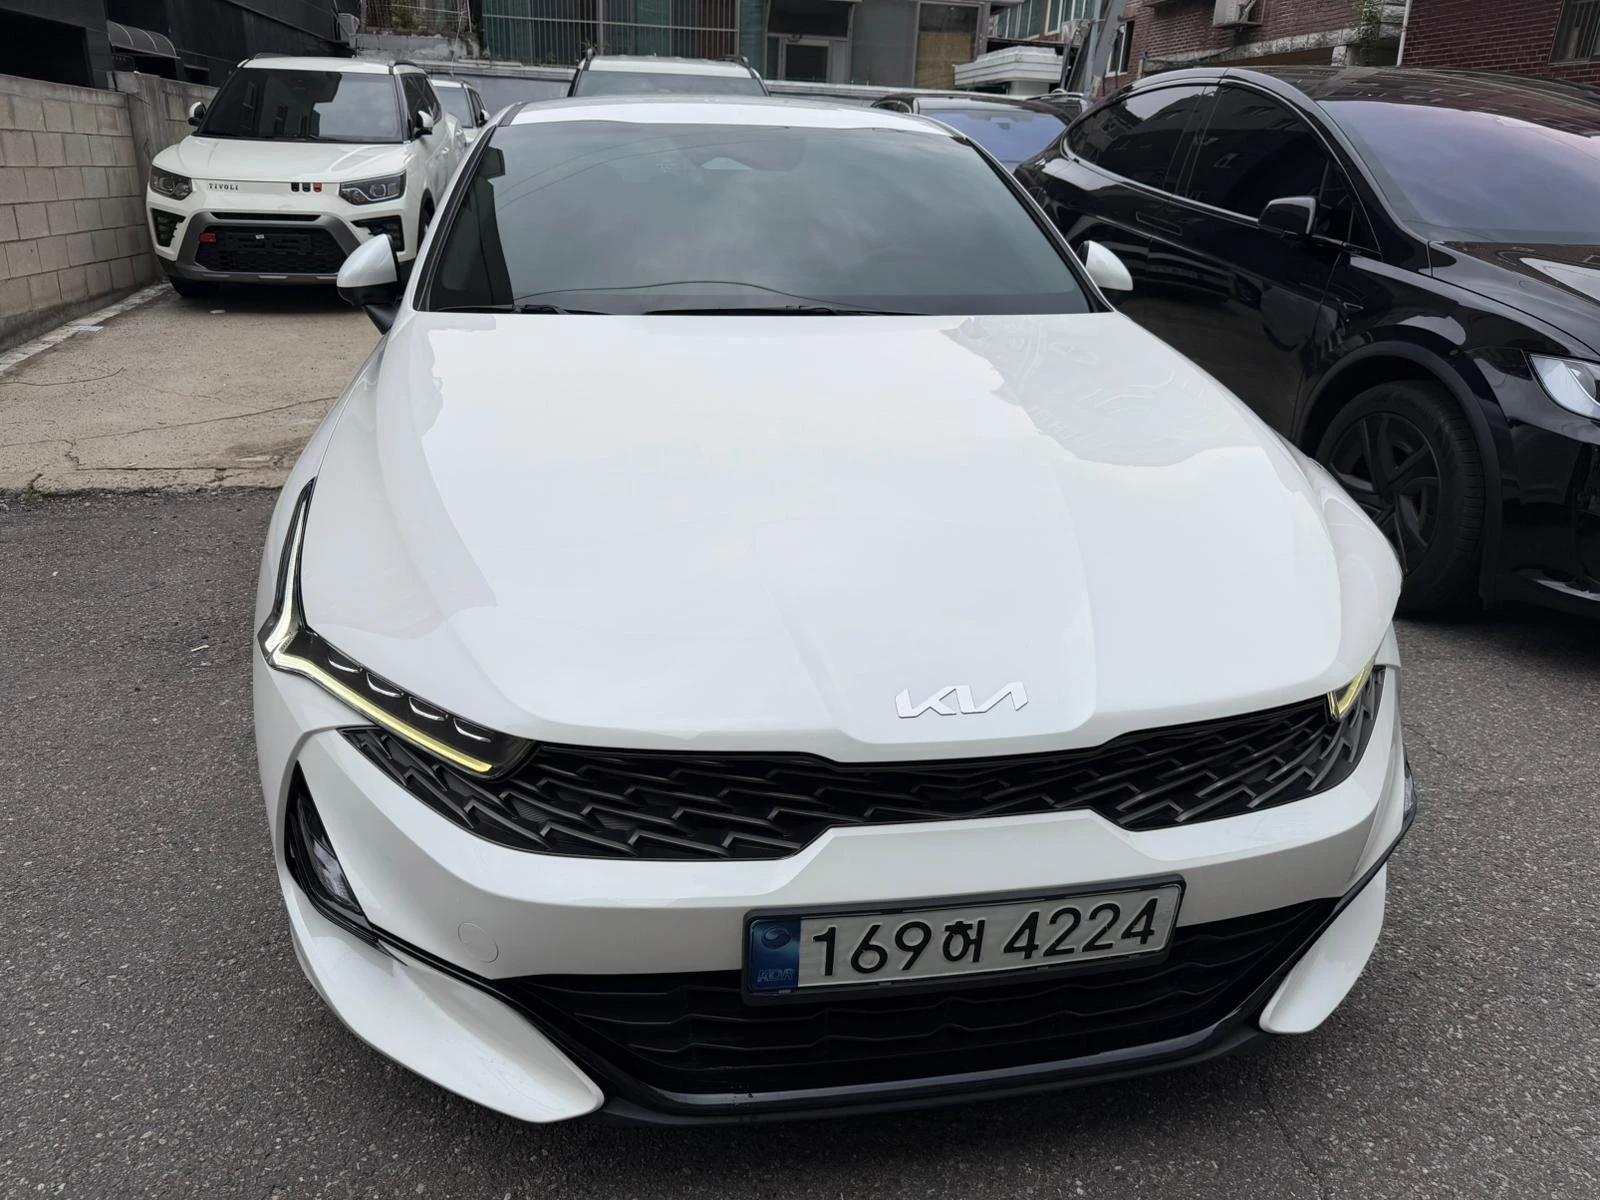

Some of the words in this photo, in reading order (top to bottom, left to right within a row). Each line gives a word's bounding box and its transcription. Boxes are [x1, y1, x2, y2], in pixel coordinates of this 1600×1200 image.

[208, 183, 239, 191] TIVOLI
[895, 681, 1028, 719] KIA
[812, 919, 986, 976] 169허
[1003, 897, 1159, 960] 4224
